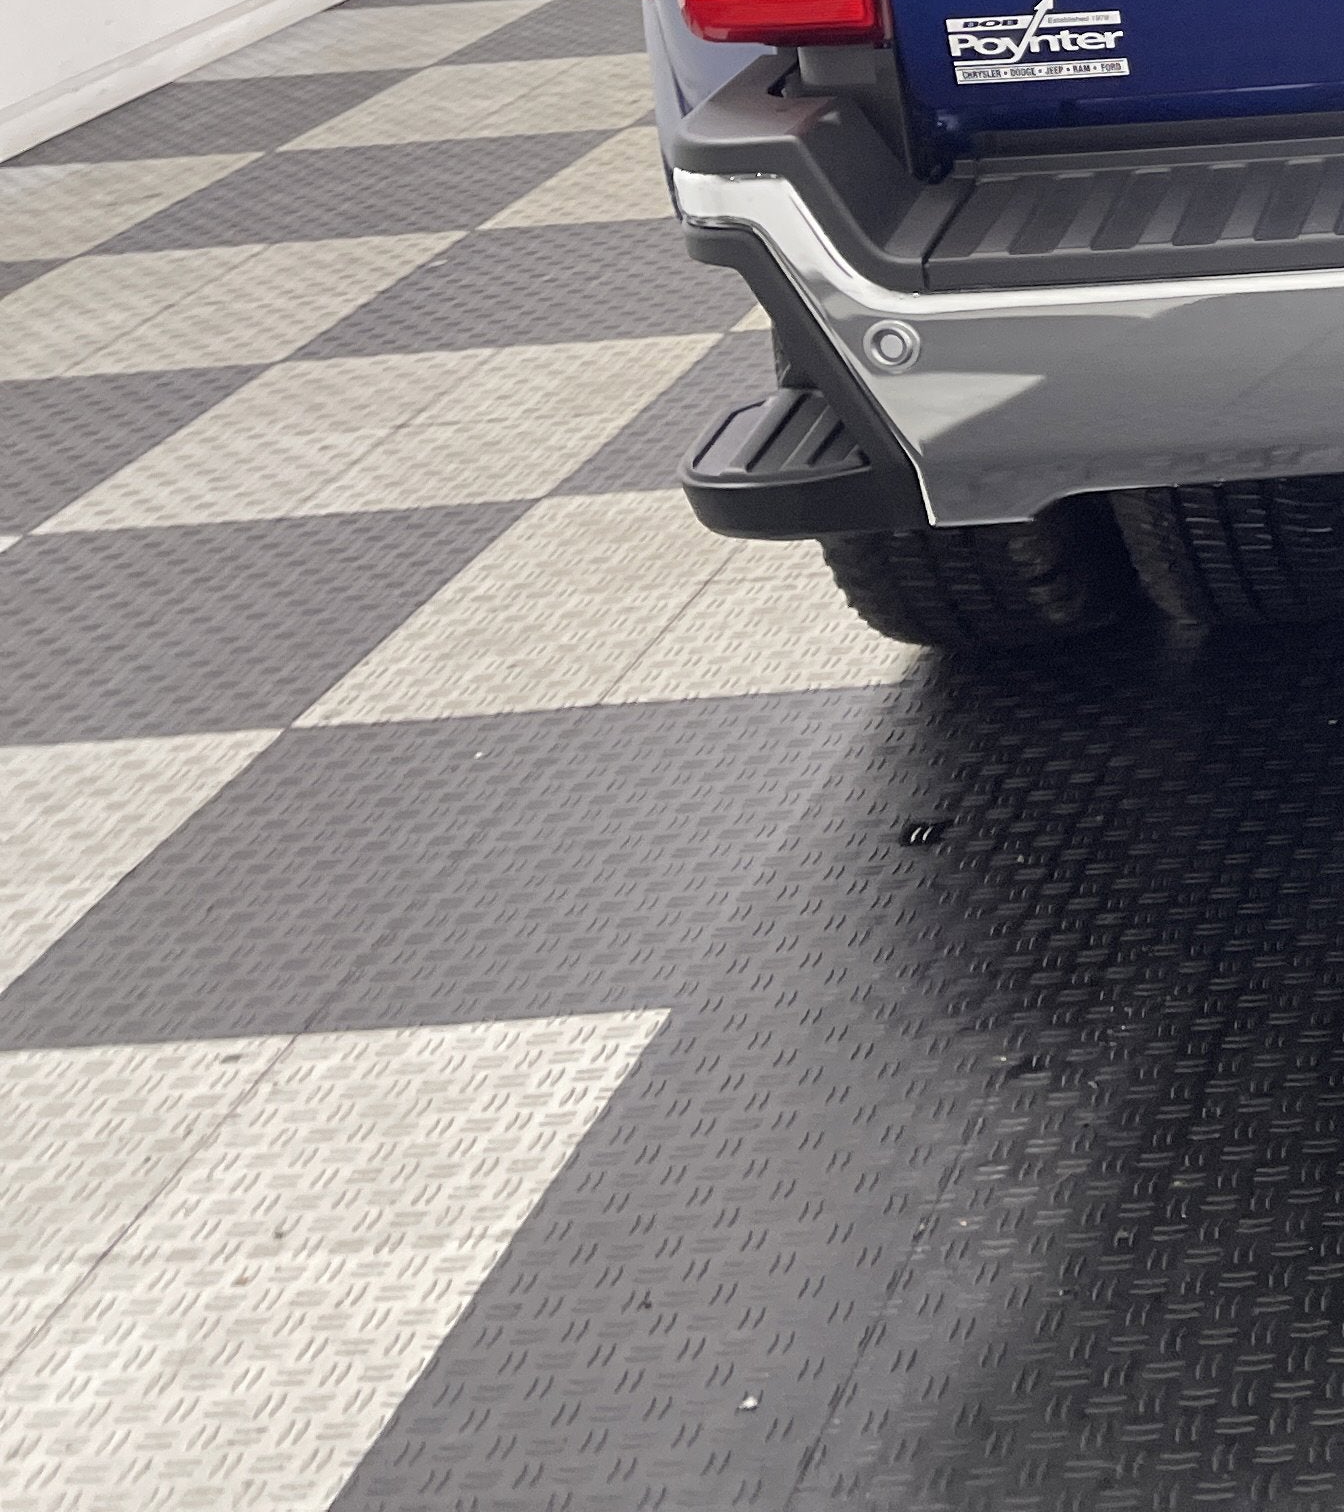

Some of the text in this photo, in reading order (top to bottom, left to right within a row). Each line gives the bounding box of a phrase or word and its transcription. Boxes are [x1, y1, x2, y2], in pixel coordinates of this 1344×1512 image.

[963, 19, 1019, 29] BOB
[947, 29, 1124, 62] Poynter
[961, 62, 1122, 80] CHRYSLER DODGE JEEP RAM FORD
